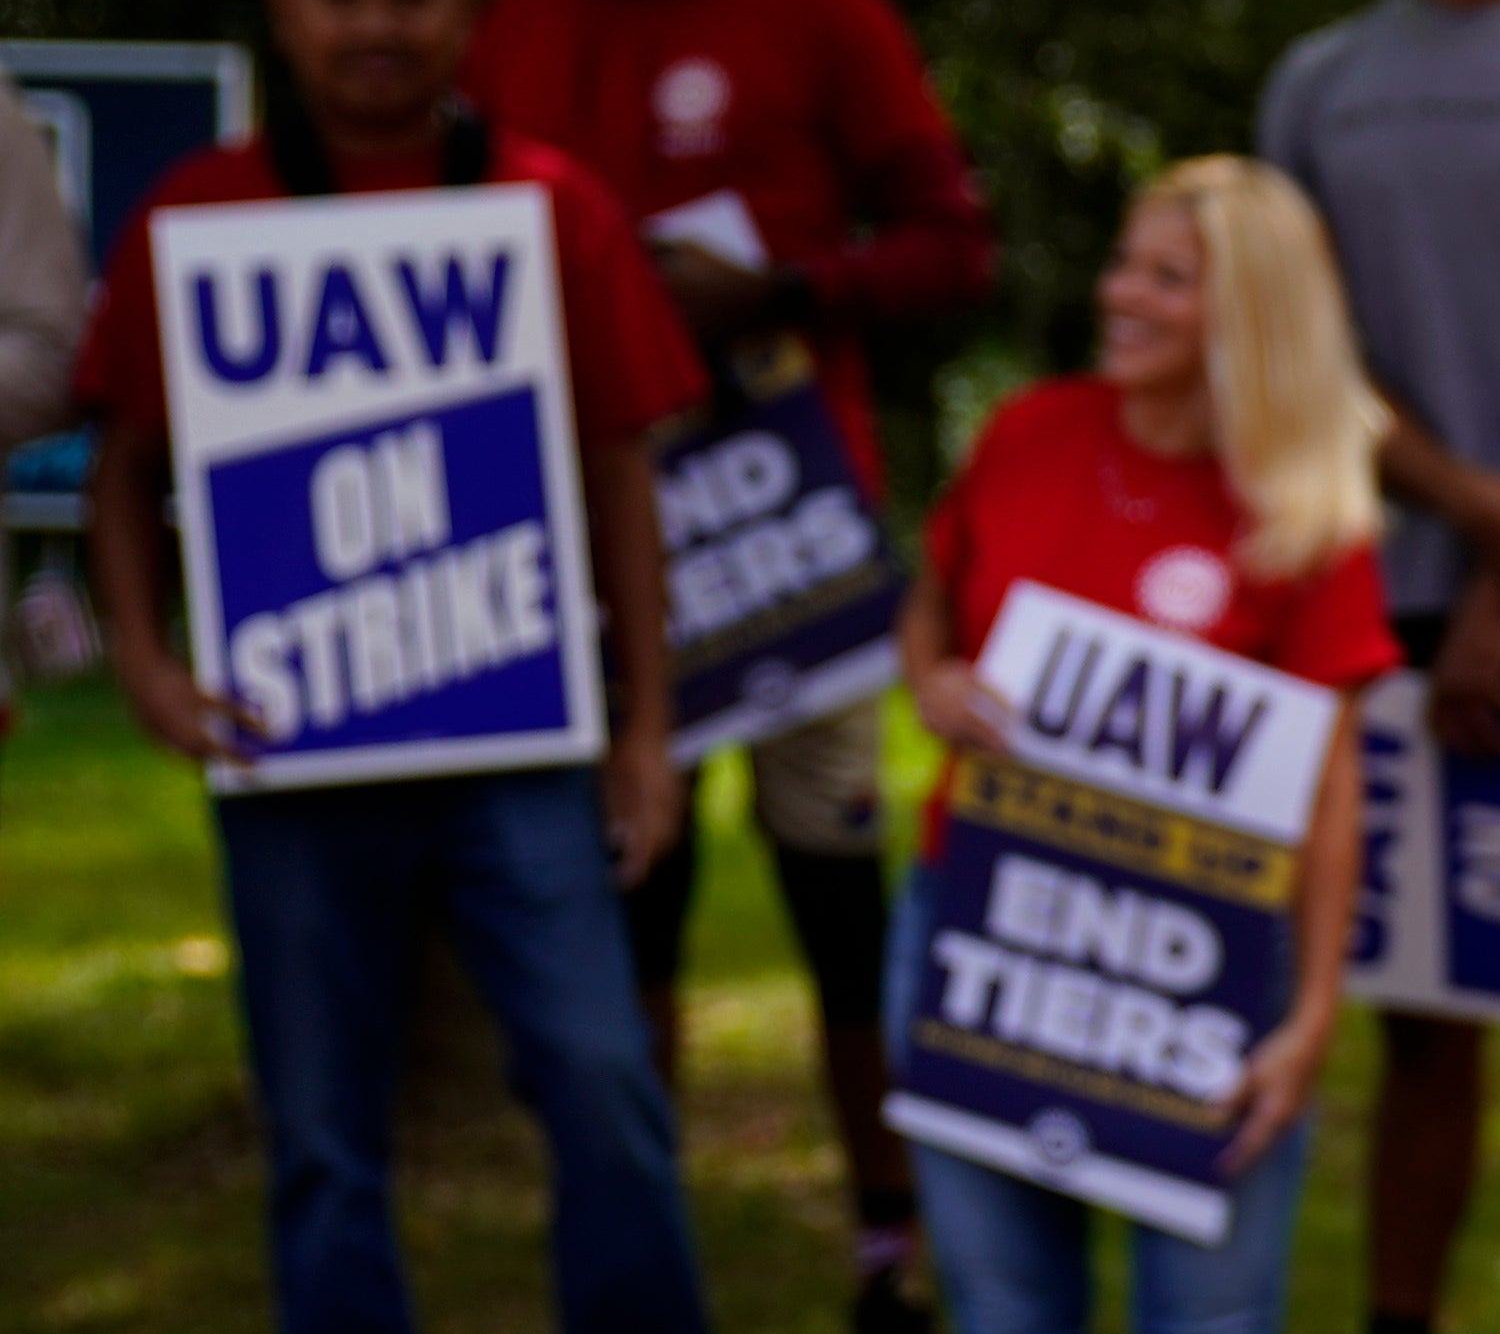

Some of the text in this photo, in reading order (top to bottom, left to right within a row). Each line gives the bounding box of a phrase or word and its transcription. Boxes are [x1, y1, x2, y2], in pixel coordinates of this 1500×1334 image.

[187, 242, 520, 387] UAW
[309, 419, 453, 582] ON
[654, 431, 796, 555] ND
[667, 483, 875, 652] ERS
[228, 520, 552, 743] STRIKE
[1025, 628, 1270, 795] UAW
[986, 853, 1222, 995] END
[932, 929, 1250, 1099] TIERS
